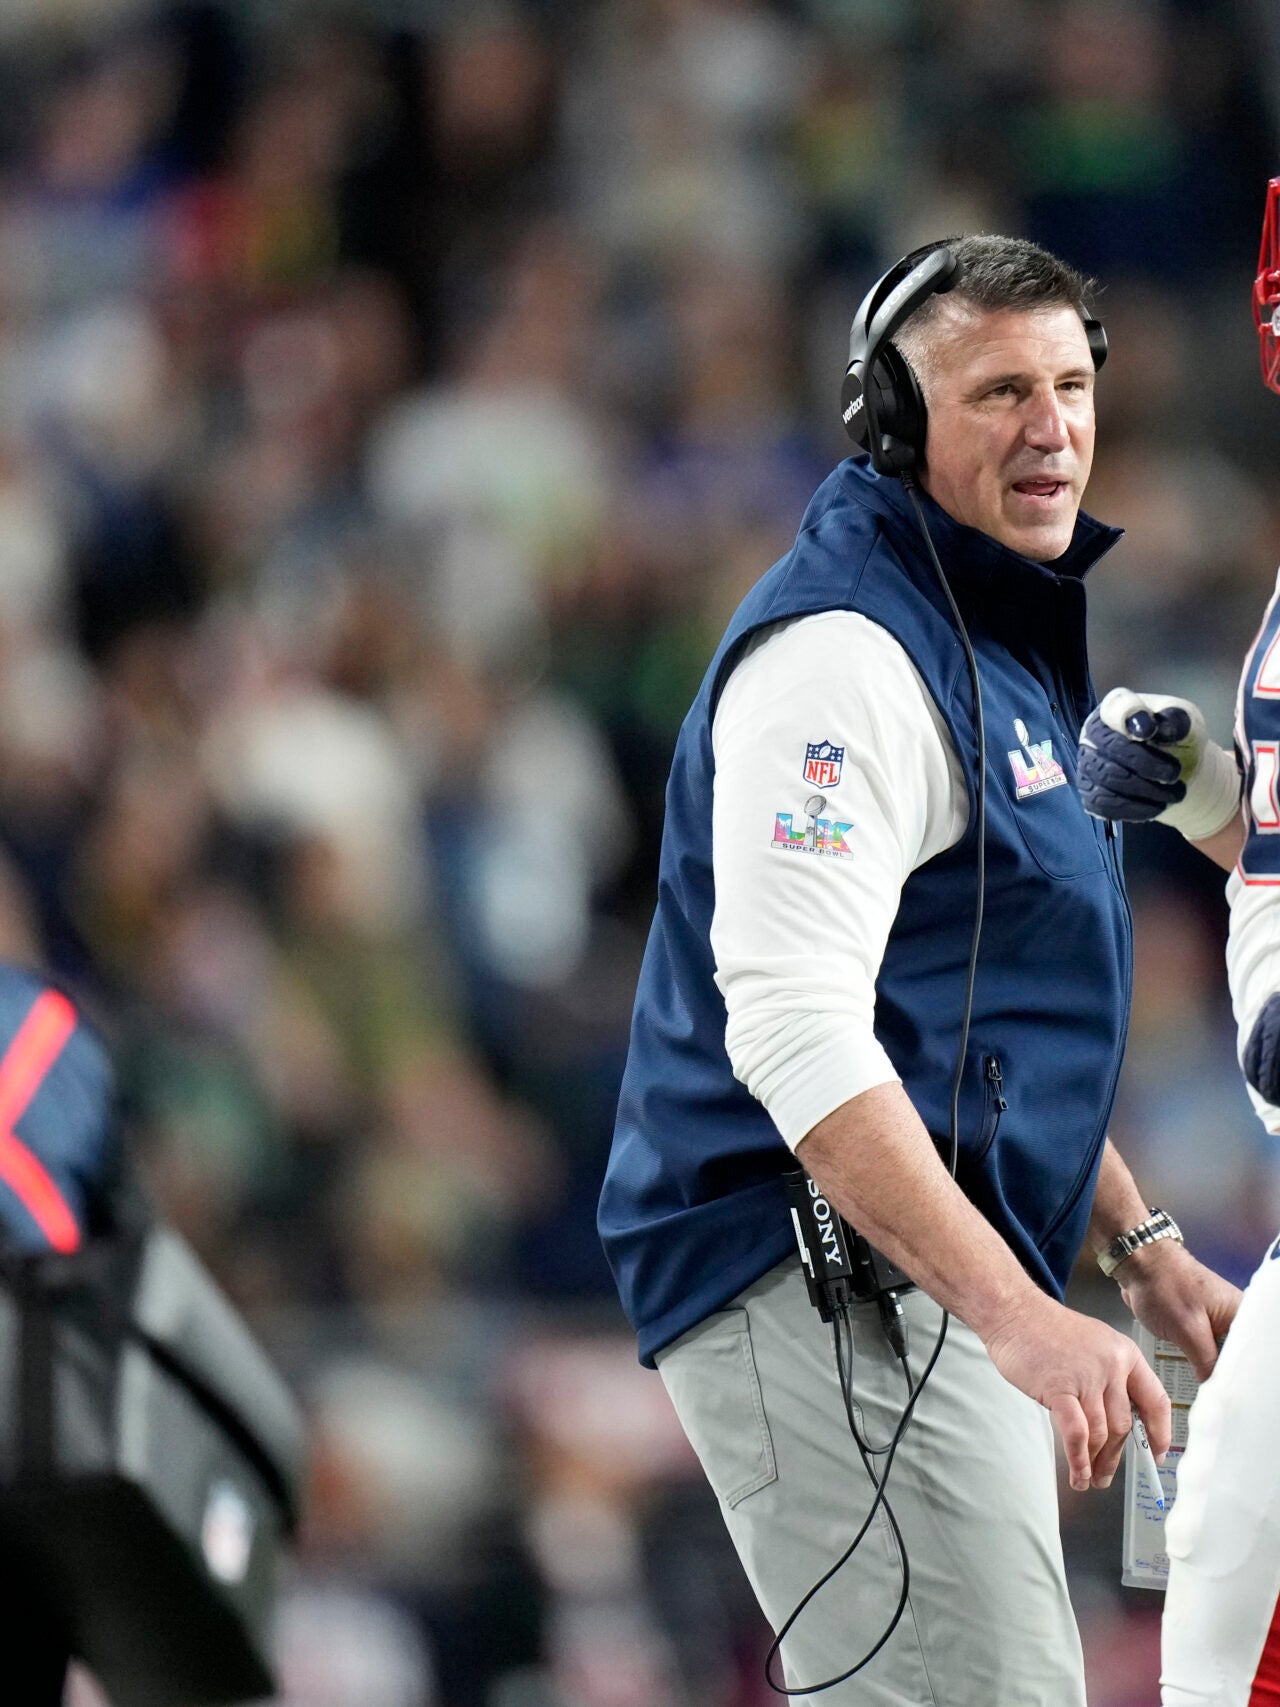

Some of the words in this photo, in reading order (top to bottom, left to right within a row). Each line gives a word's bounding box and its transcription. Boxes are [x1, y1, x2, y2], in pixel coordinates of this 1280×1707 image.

[880, 267, 924, 319] SONY
[806, 760, 838, 785] NFL
[782, 842, 815, 853] SUPER
[819, 848, 845, 858] BOWL
